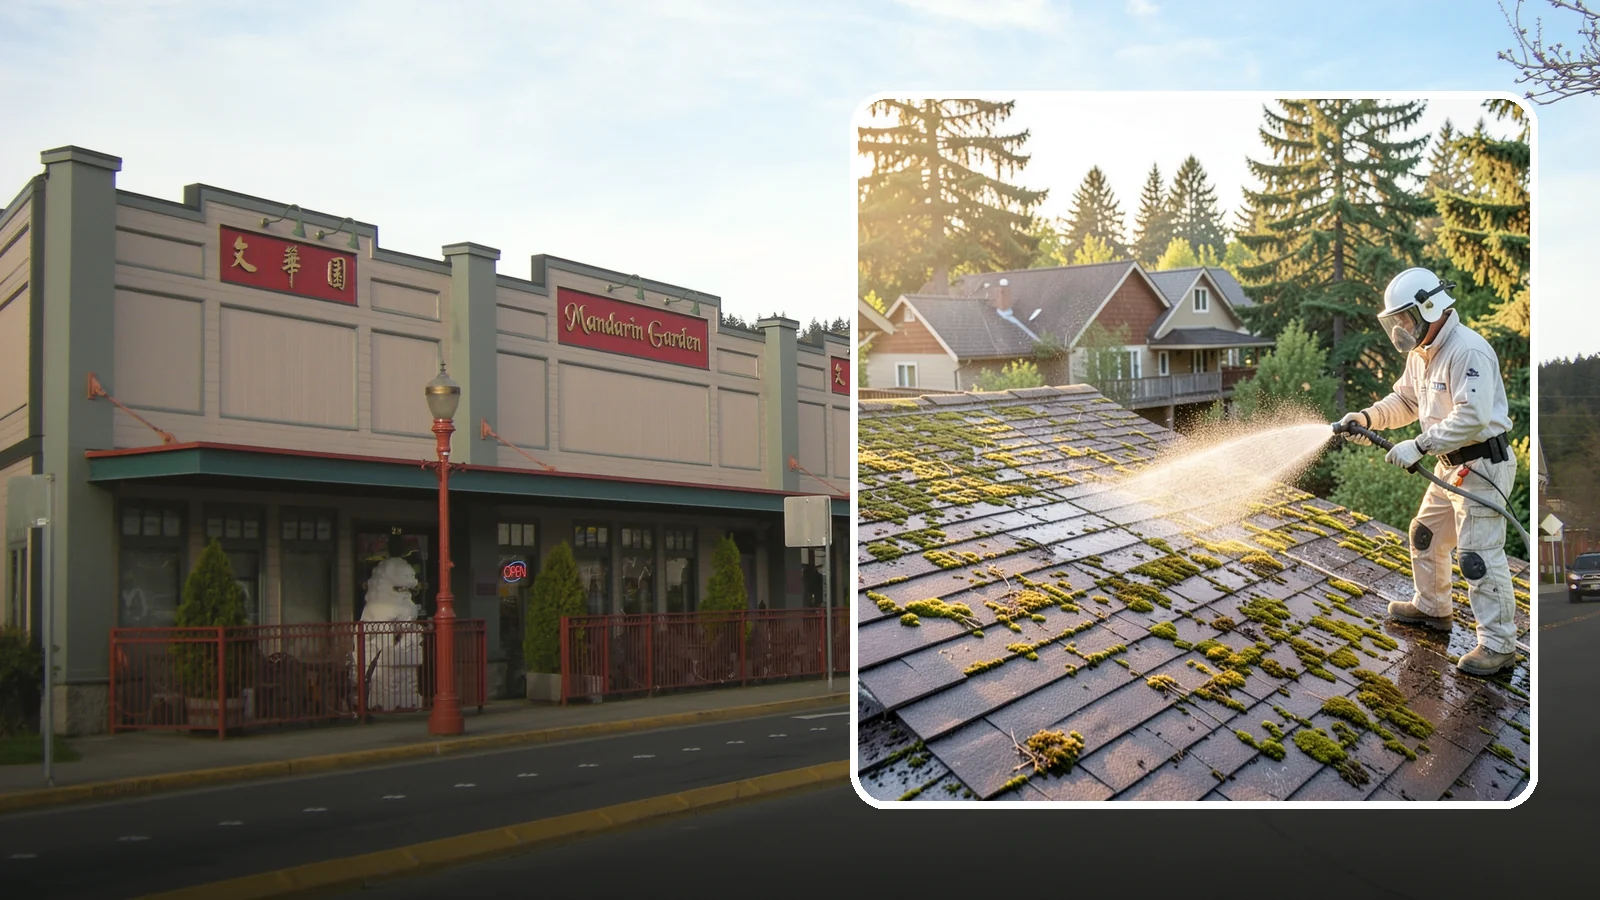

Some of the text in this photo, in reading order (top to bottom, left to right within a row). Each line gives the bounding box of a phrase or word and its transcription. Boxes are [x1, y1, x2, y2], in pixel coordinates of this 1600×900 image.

[564, 302, 702, 352] Mandarin Garden
[503, 565, 527, 578] OPEN
